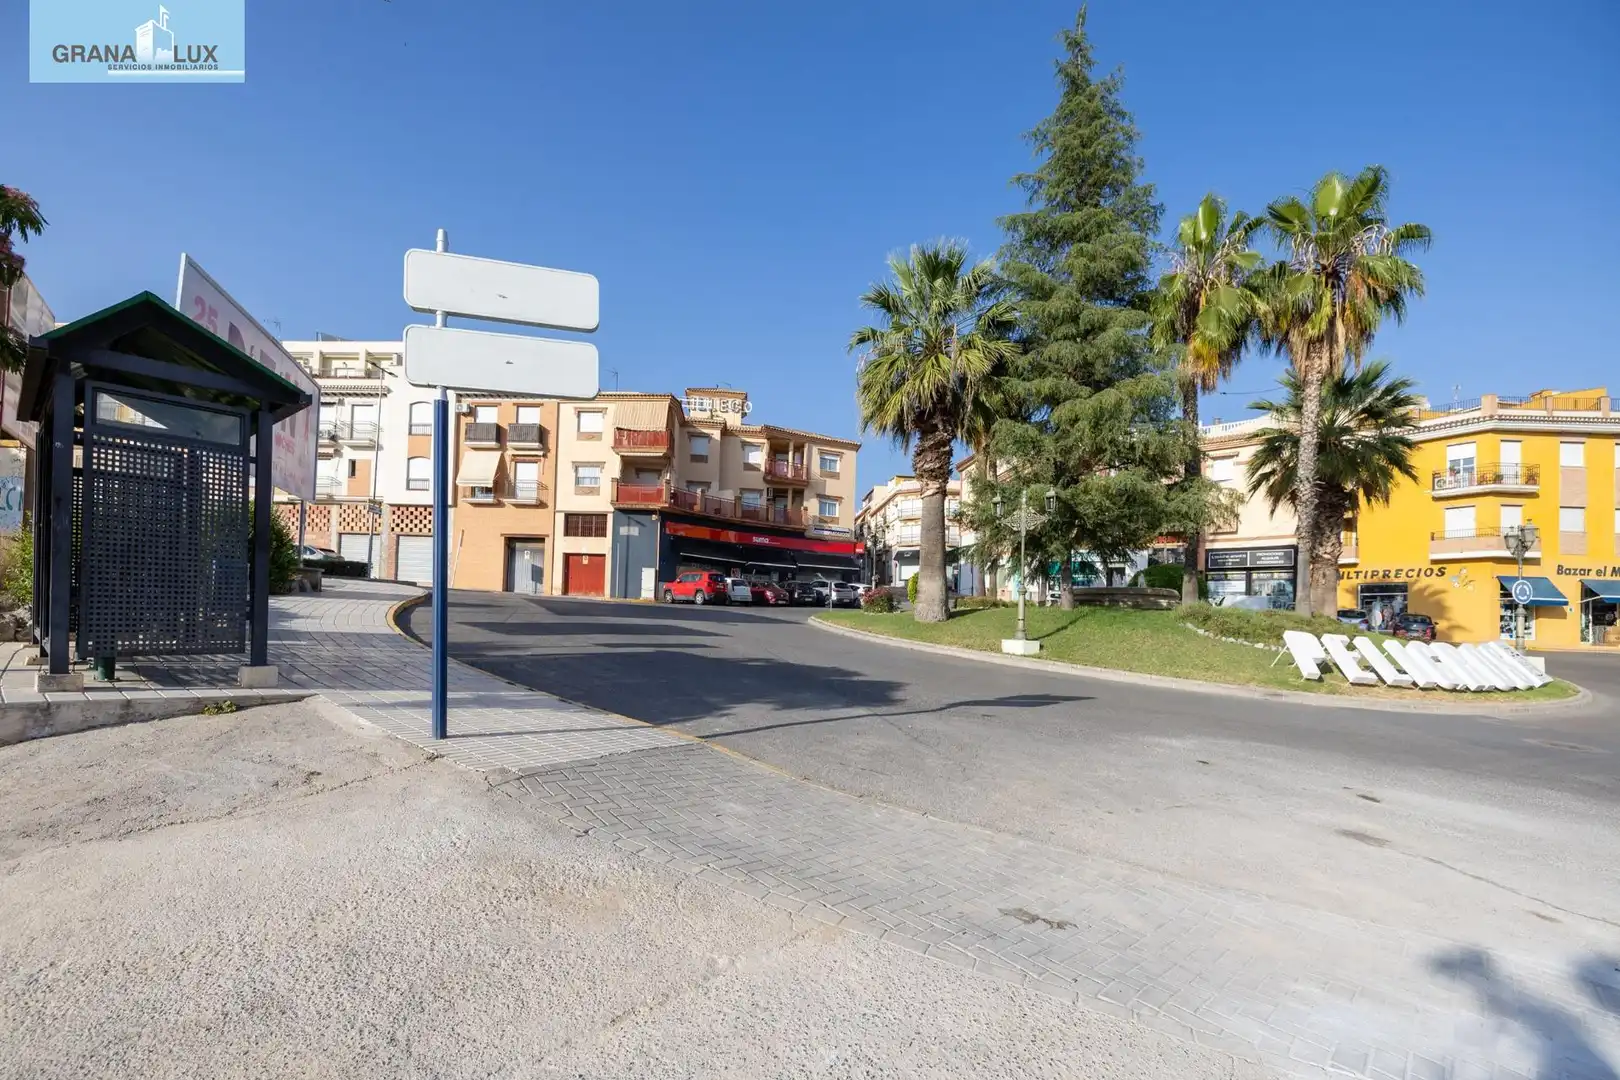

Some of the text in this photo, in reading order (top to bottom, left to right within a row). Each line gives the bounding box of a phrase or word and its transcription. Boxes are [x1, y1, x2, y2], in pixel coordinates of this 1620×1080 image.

[1338, 566, 1447, 580] LTIPRECIOS
[1556, 564, 1592, 577] Bazar
[1595, 565, 1608, 577] el
